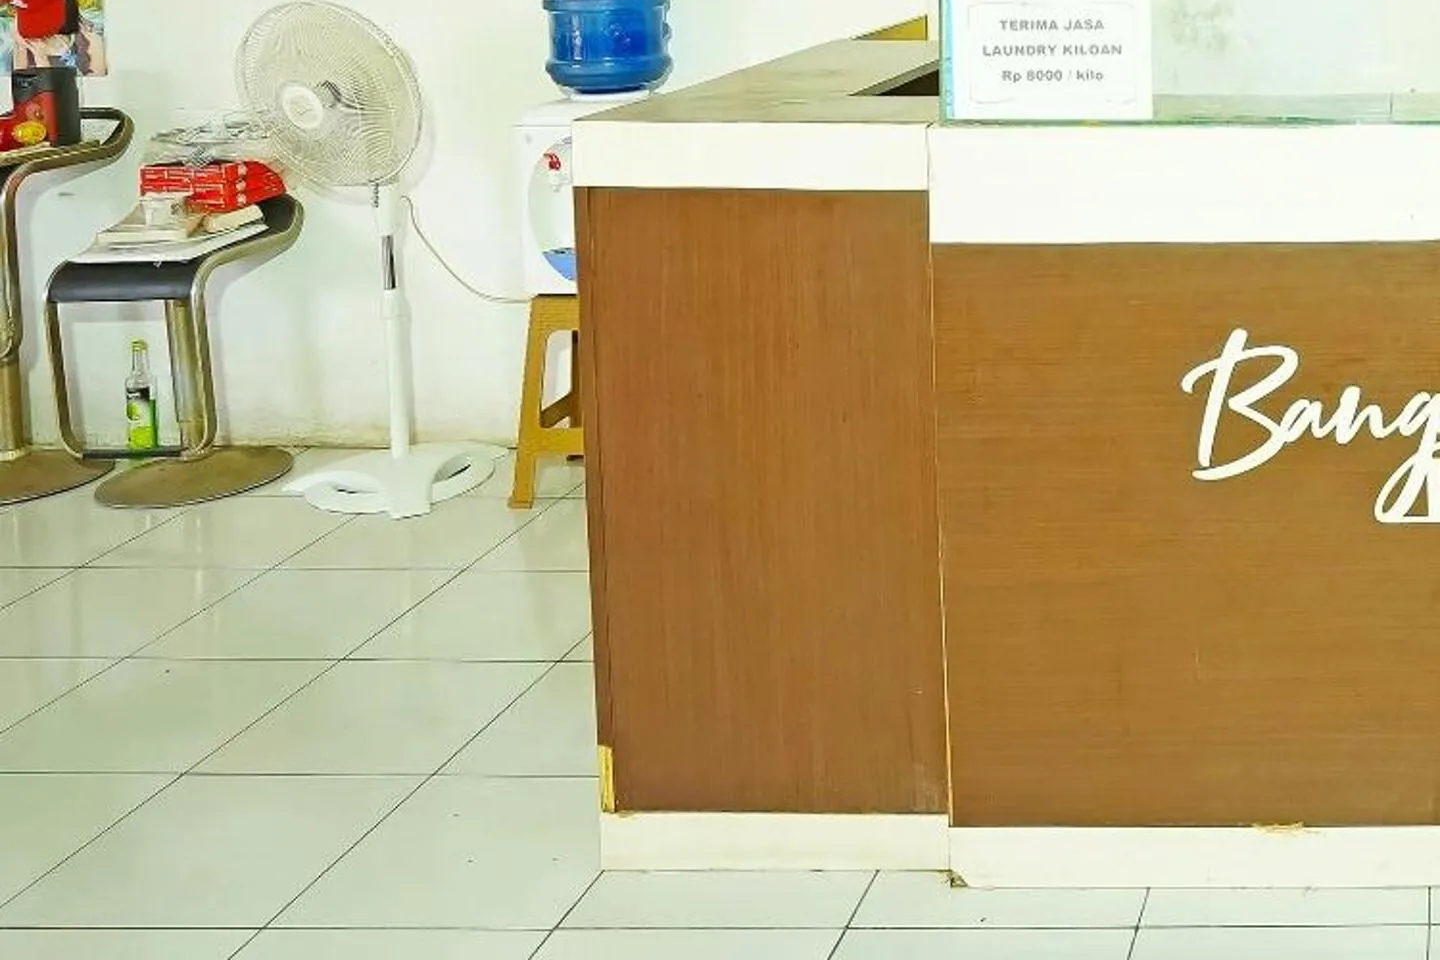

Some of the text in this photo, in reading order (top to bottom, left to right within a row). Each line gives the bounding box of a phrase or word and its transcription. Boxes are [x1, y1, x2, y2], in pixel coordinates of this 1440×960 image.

[999, 19, 1105, 31] TERIMA JASA
[982, 44, 1122, 56] LAUNDRY KILOAN
[1001, 69, 1022, 83] Rp
[1076, 69, 1105, 81] kilo
